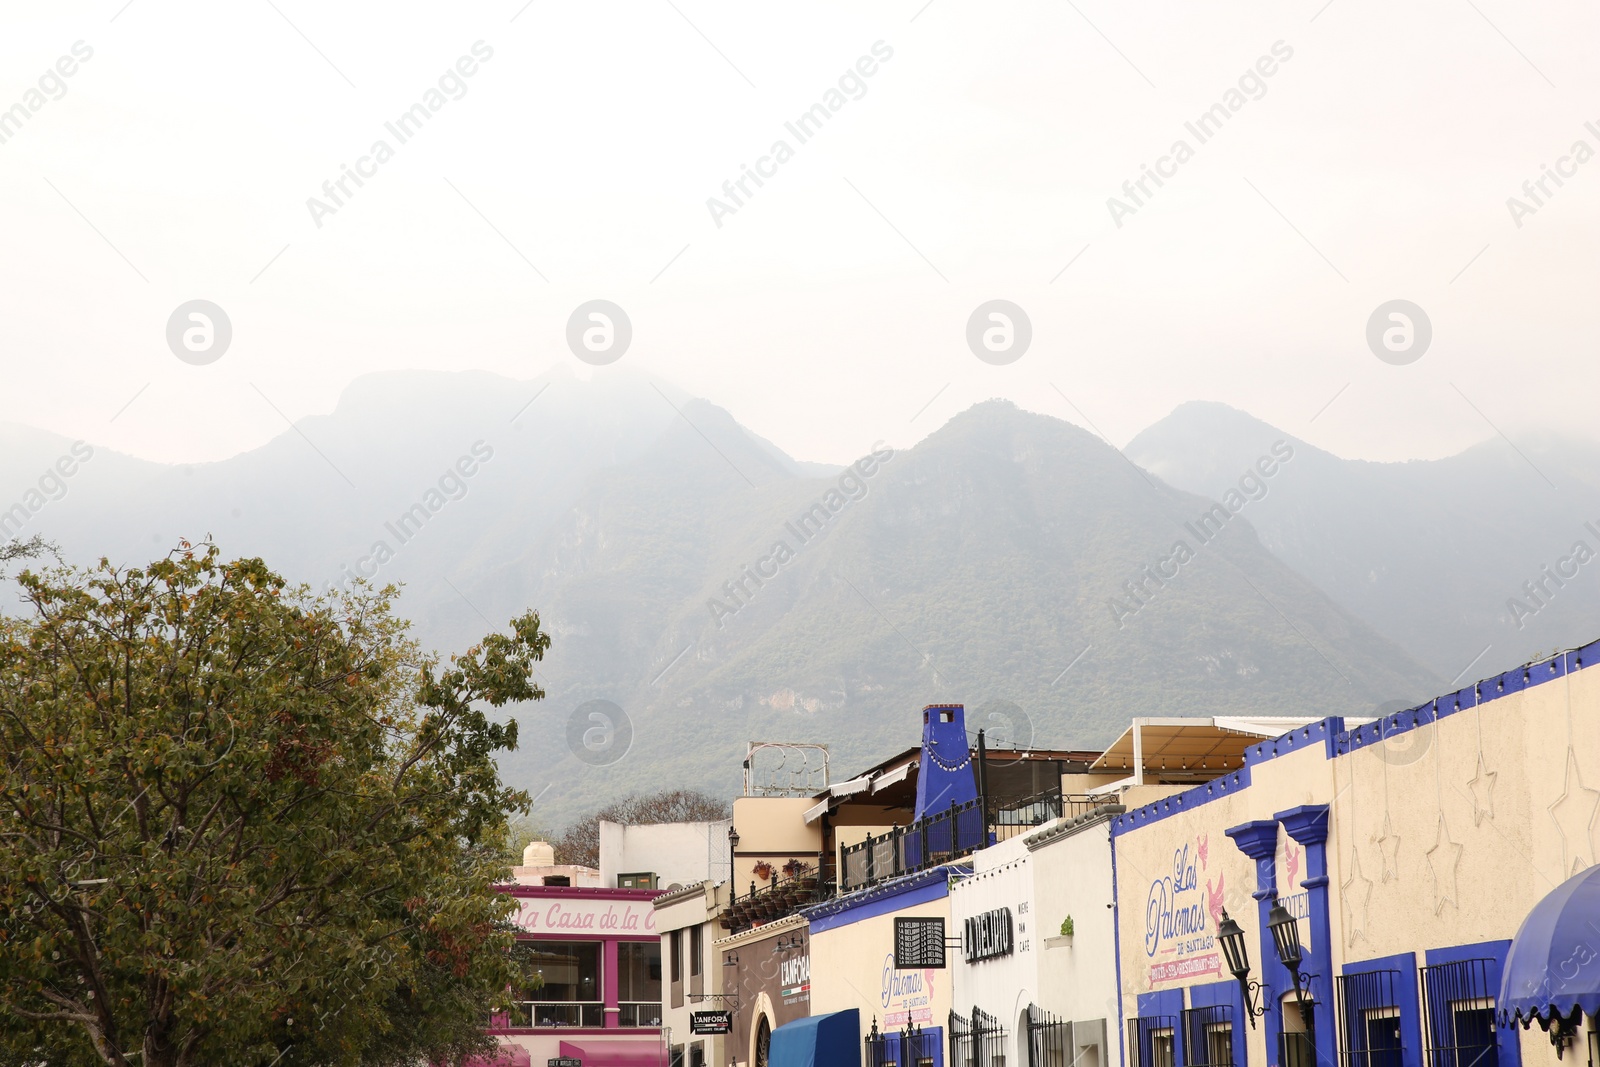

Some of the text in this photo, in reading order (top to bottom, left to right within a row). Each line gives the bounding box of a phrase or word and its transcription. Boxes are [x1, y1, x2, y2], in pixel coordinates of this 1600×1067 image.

[1173, 843, 1198, 894] Las
[511, 902, 540, 928] La
[546, 902, 595, 929] Casa
[600, 905, 618, 930] de
[620, 905, 639, 930] la
[964, 907, 1010, 961] LA DELIRIO
[1145, 876, 1205, 957] Palomas
[1177, 935, 1214, 955] DE SANTIAGO
[881, 953, 922, 1009] Palomas
[694, 1015, 728, 1024] L'ANFORA
